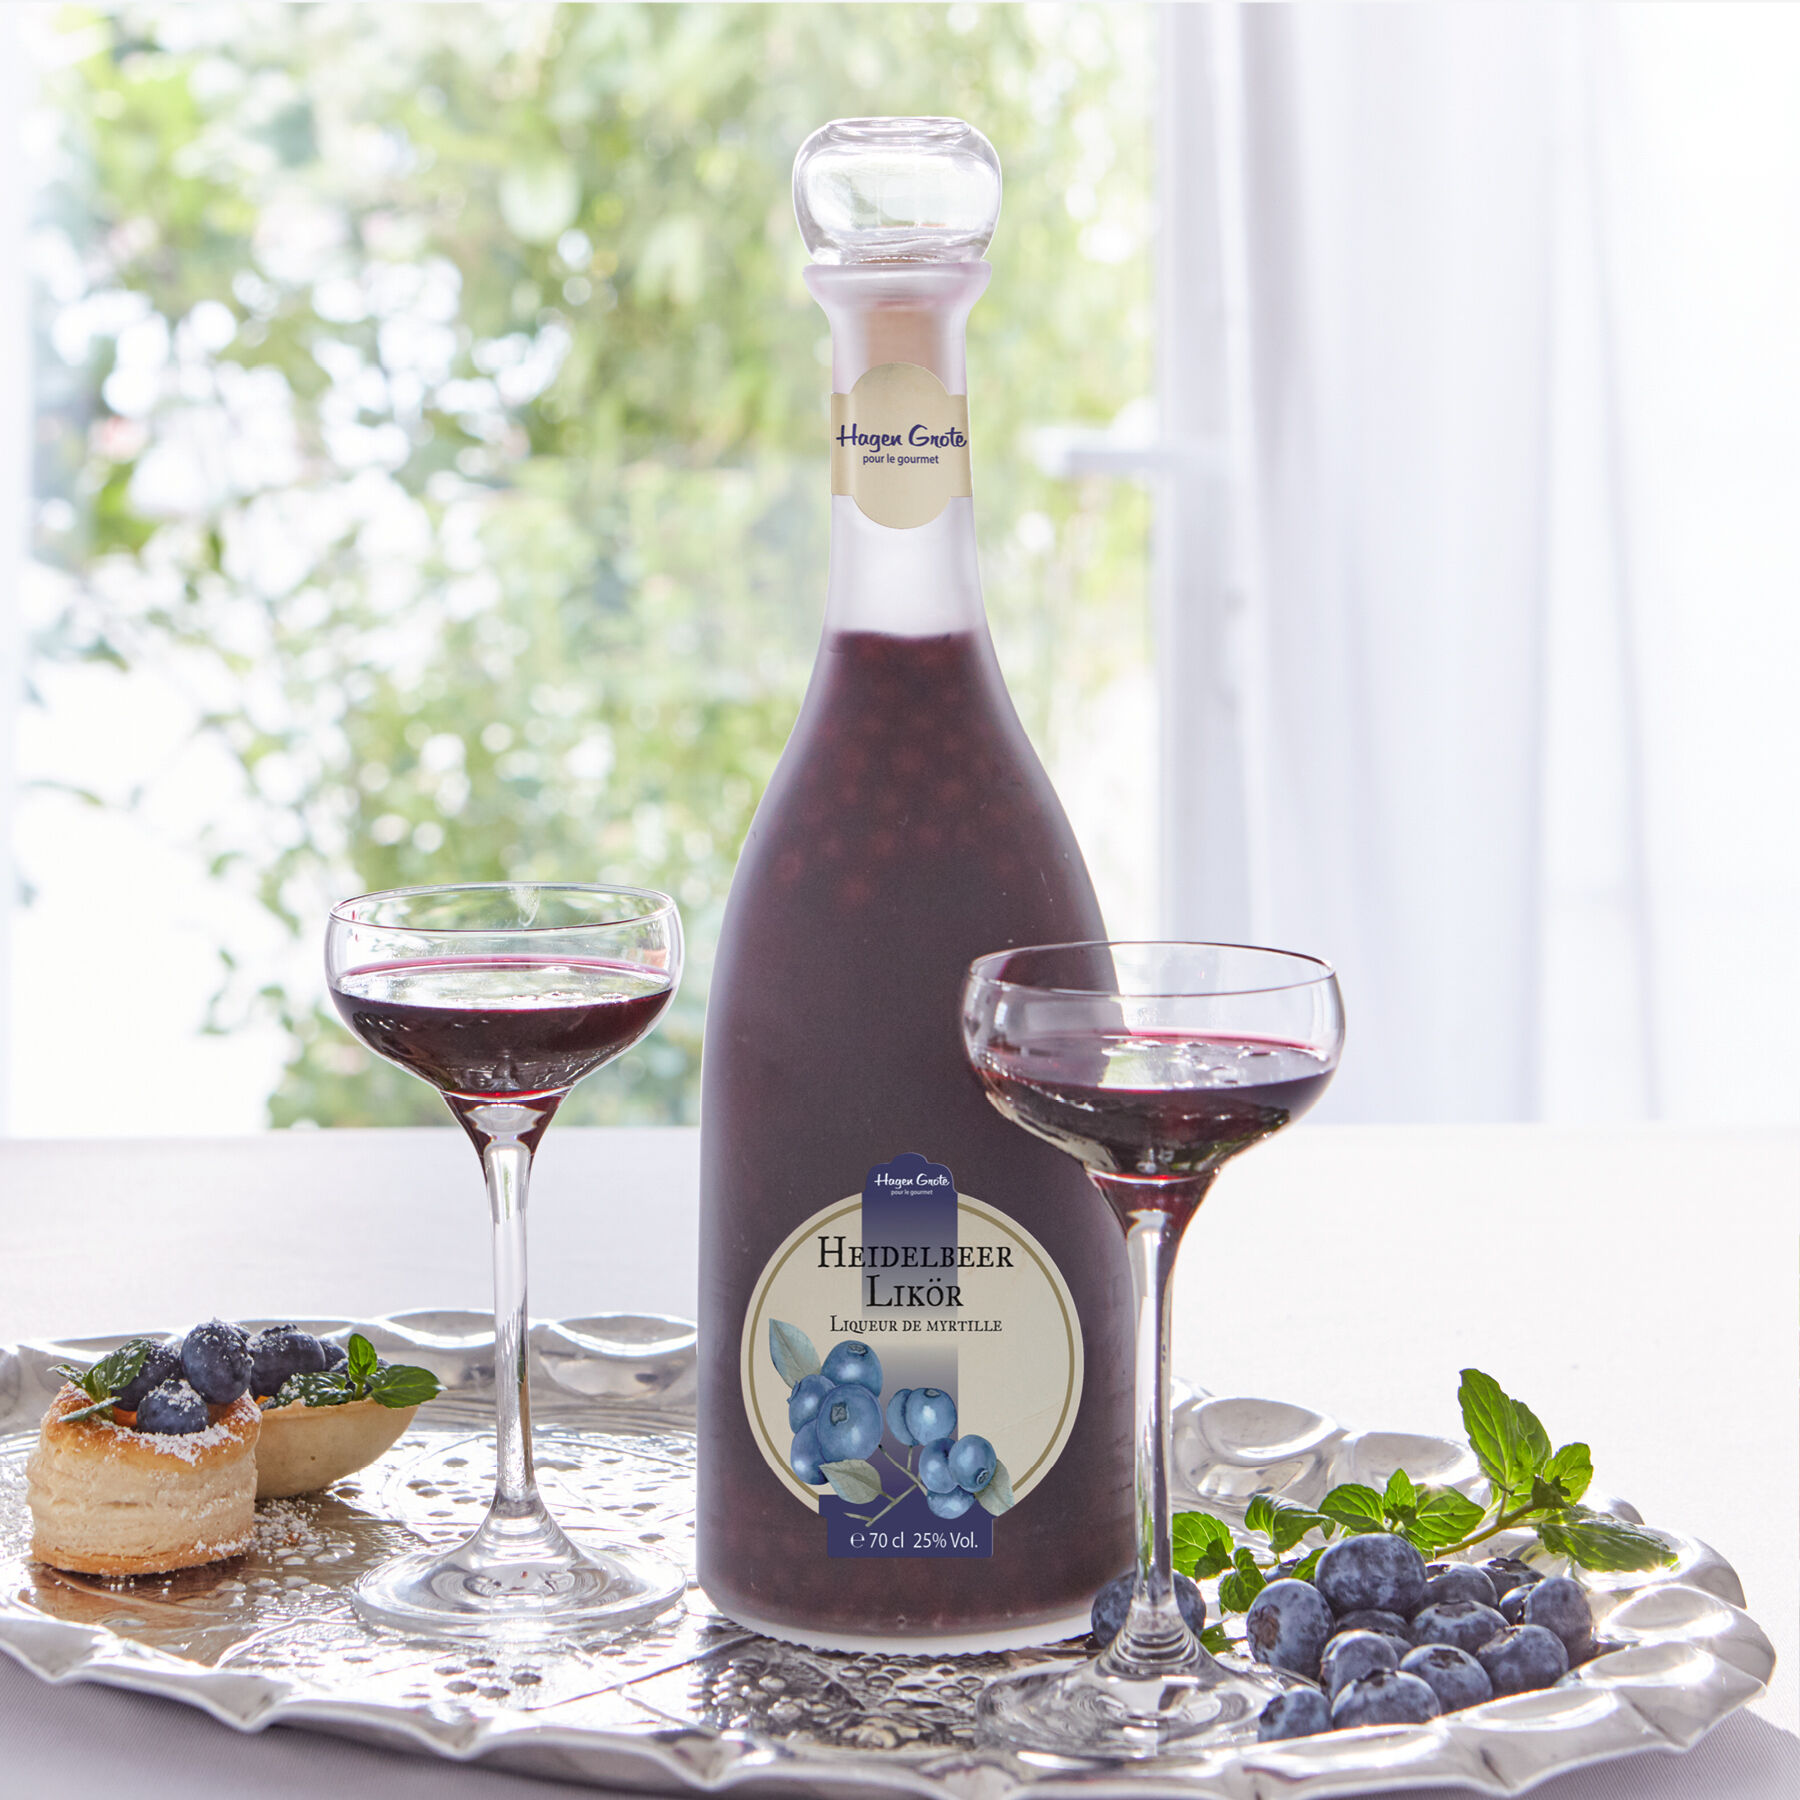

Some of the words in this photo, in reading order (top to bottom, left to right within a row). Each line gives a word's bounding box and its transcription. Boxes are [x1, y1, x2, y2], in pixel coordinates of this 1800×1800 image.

[836, 423, 903, 453] Hagen
[908, 424, 967, 448] Grote
[862, 454, 884, 465] pour
[887, 453, 895, 463] le
[897, 455, 939, 466] gourmet
[874, 1172, 913, 1189] Hagen
[916, 1173, 950, 1186] Grote
[869, 1532, 888, 1548] 70
[892, 1531, 904, 1548] cl
[913, 1532, 947, 1548] 25%
[949, 1531, 978, 1548] Vol.
